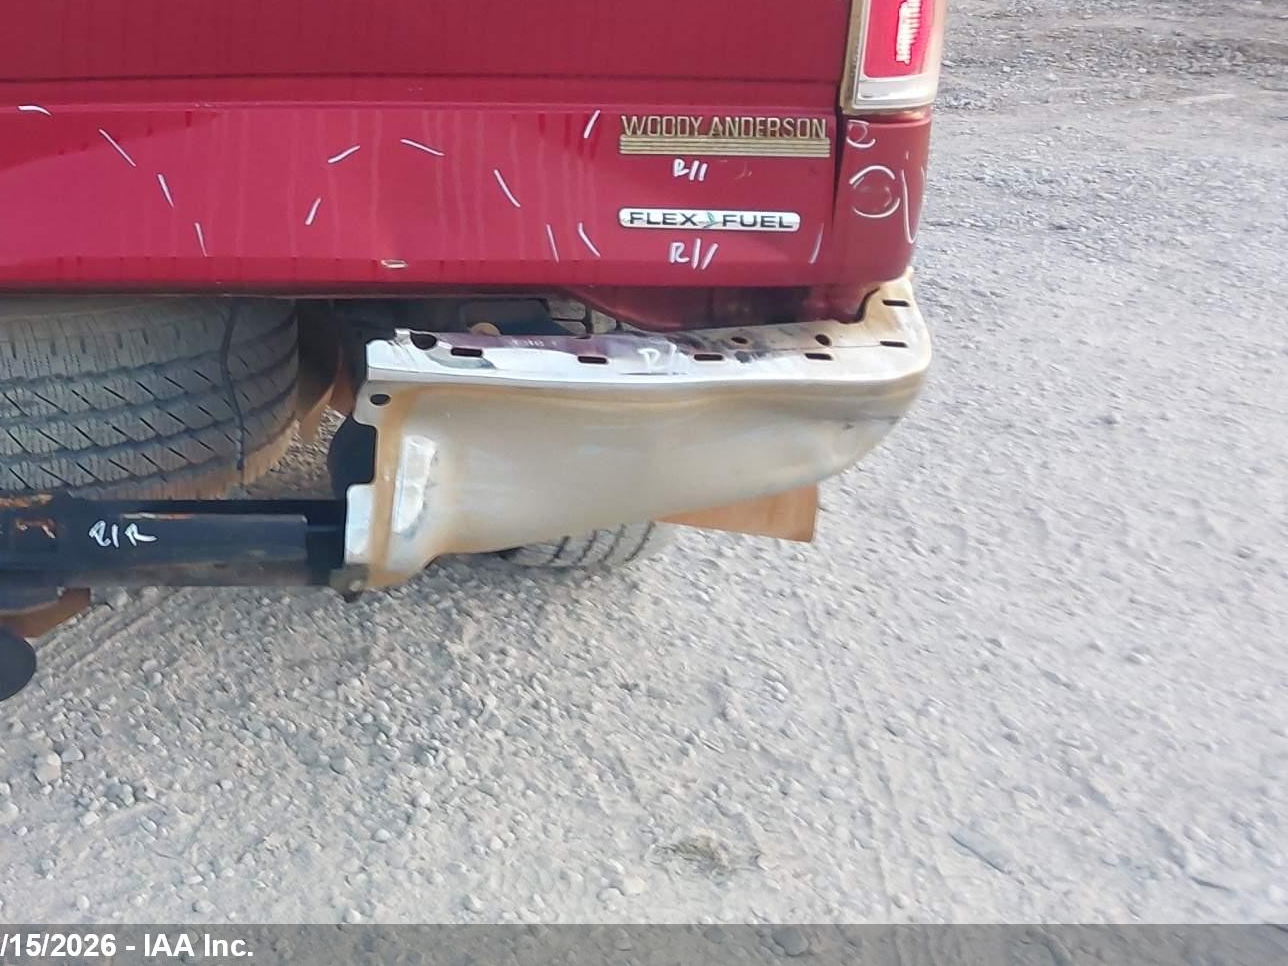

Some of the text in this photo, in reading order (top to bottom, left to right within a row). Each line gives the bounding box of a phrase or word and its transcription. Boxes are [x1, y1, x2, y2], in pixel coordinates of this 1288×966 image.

[621, 115, 826, 139] WOODY ANDERSON
[629, 211, 794, 229] FLEX FUEL
